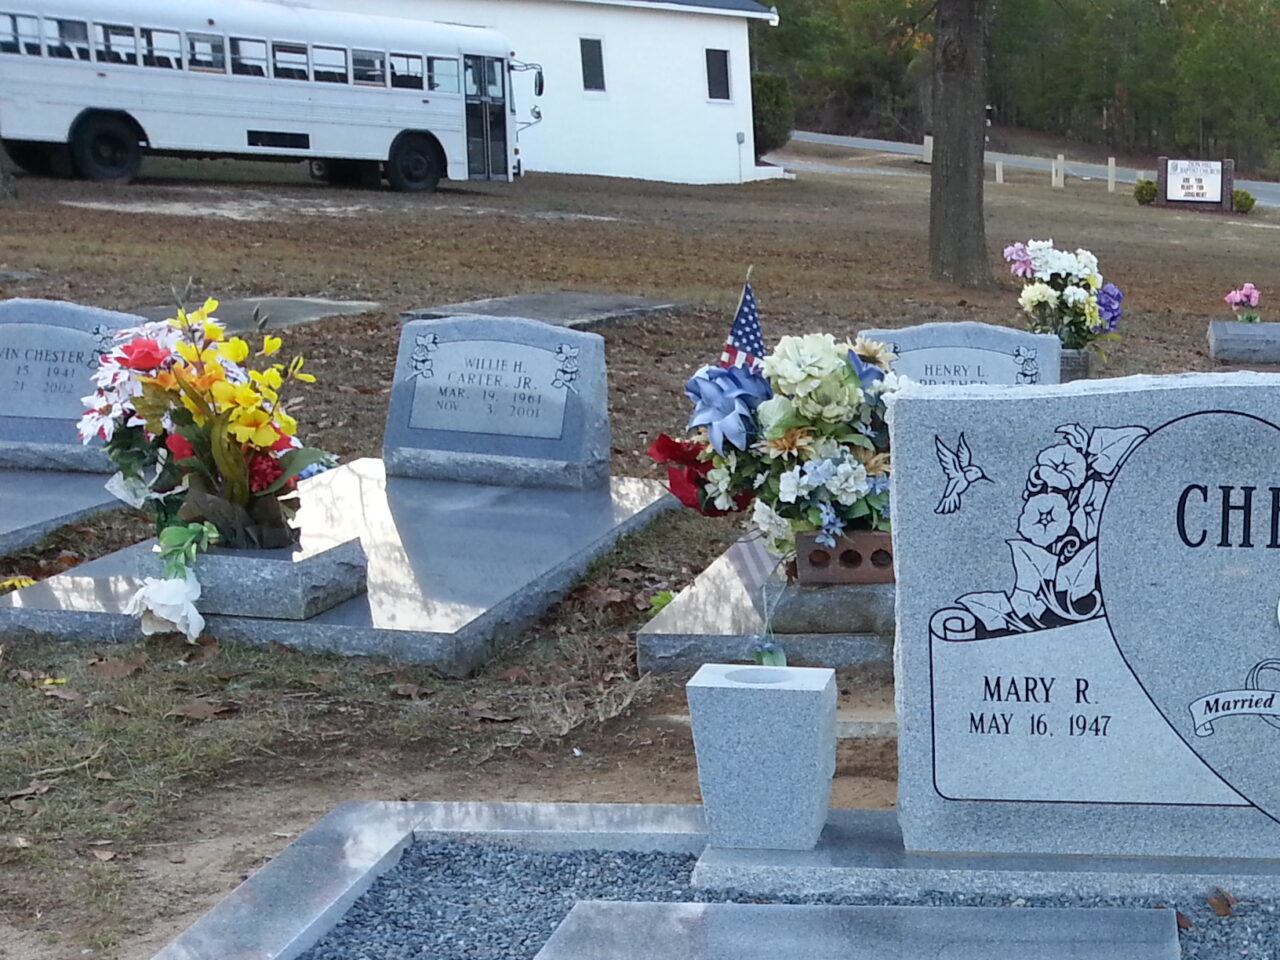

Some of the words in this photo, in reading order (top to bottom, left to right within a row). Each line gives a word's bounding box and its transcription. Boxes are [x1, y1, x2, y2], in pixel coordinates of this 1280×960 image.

[25, 349, 84, 363] CHESTER
[47, 367, 75, 377] 1941
[465, 358, 508, 372] WILLIE
[513, 361, 527, 373] H.
[924, 364, 970, 377] HENRY
[43, 382, 74, 393] 2002
[514, 376, 537, 391] JR.
[439, 386, 470, 400] MAR.
[513, 392, 542, 405] 1961
[509, 405, 540, 418] 2001
[983, 676, 1056, 703] MARY
[1075, 678, 1099, 704] R.
[1203, 694, 1276, 716] Married
[969, 712, 1014, 735] MAY
[1069, 714, 1112, 737] 1947
